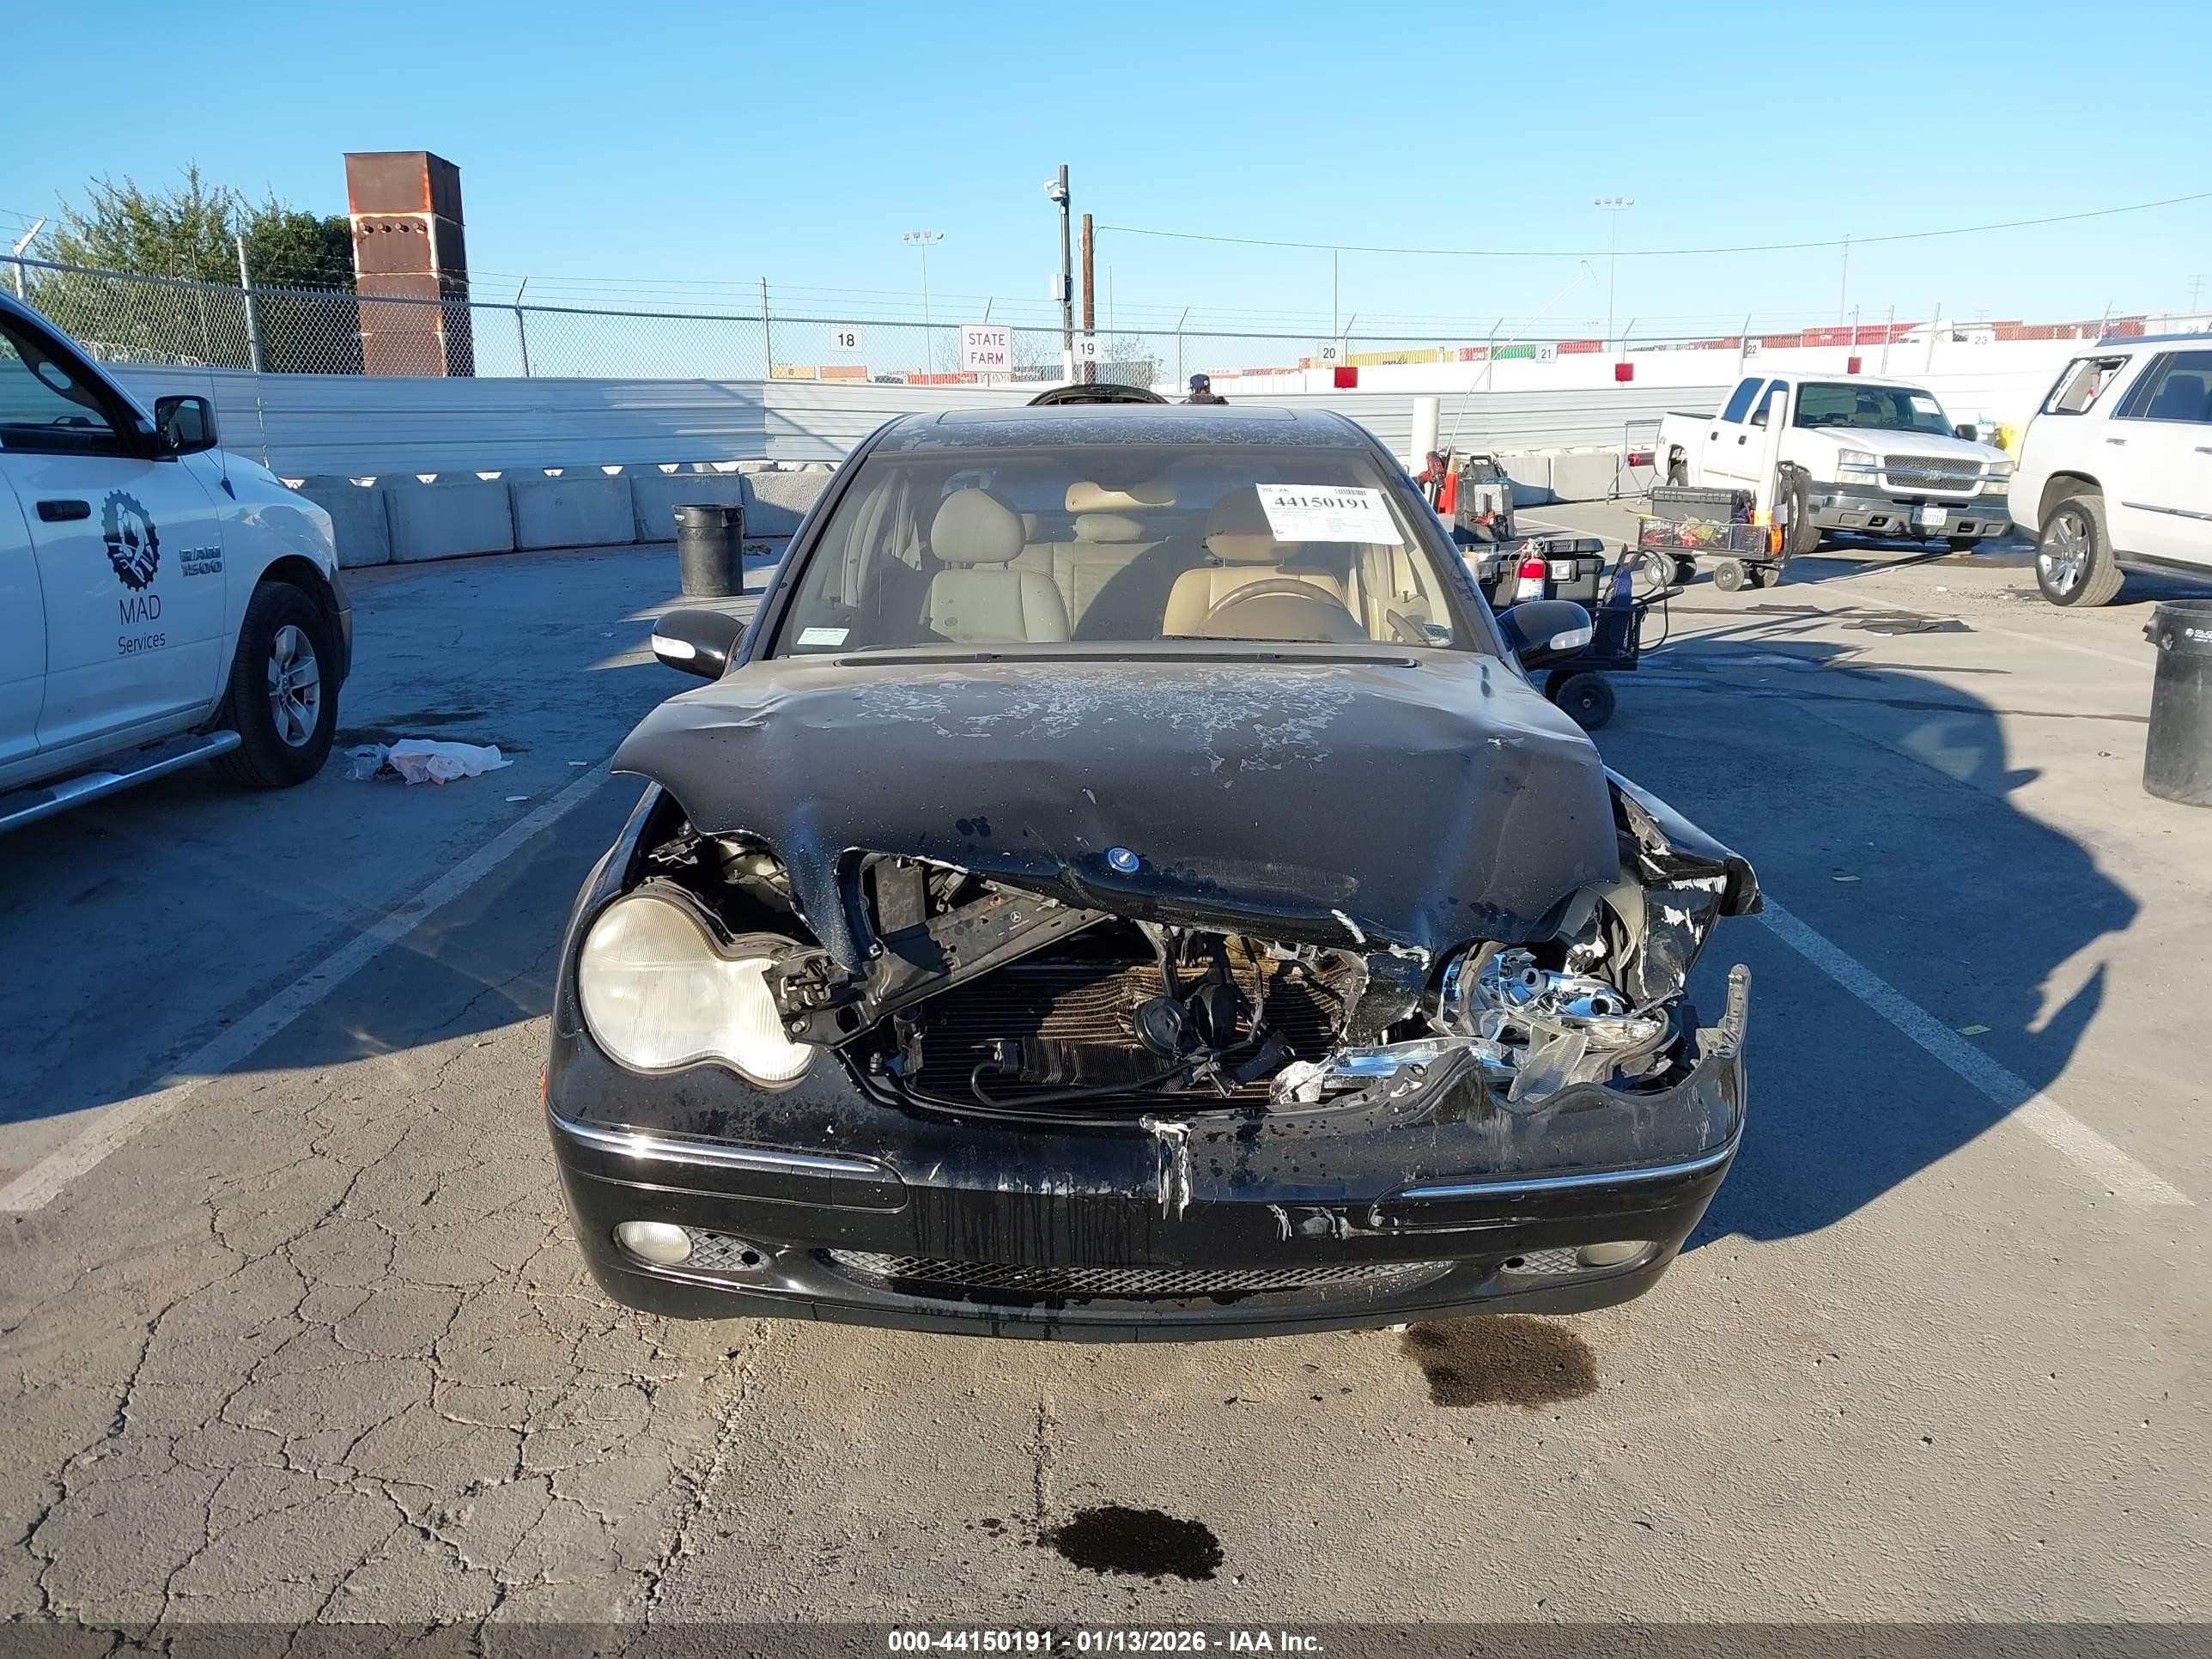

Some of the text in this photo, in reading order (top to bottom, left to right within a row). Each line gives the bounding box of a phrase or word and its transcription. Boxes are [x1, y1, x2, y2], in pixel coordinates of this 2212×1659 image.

[837, 333, 854, 347] 18
[969, 332, 1006, 346] STATE
[1975, 336, 1988, 344] 23
[1080, 343, 1095, 355] 19
[1322, 347, 1336, 359] 20
[1540, 349, 1551, 359] 21
[1747, 344, 1757, 354] 22
[970, 352, 1004, 365] FARM
[1274, 496, 1370, 509] 44150191
[179, 546, 222, 562] RAM
[180, 561, 222, 576] 1500
[119, 594, 161, 625] MAD
[118, 632, 166, 655] Services
